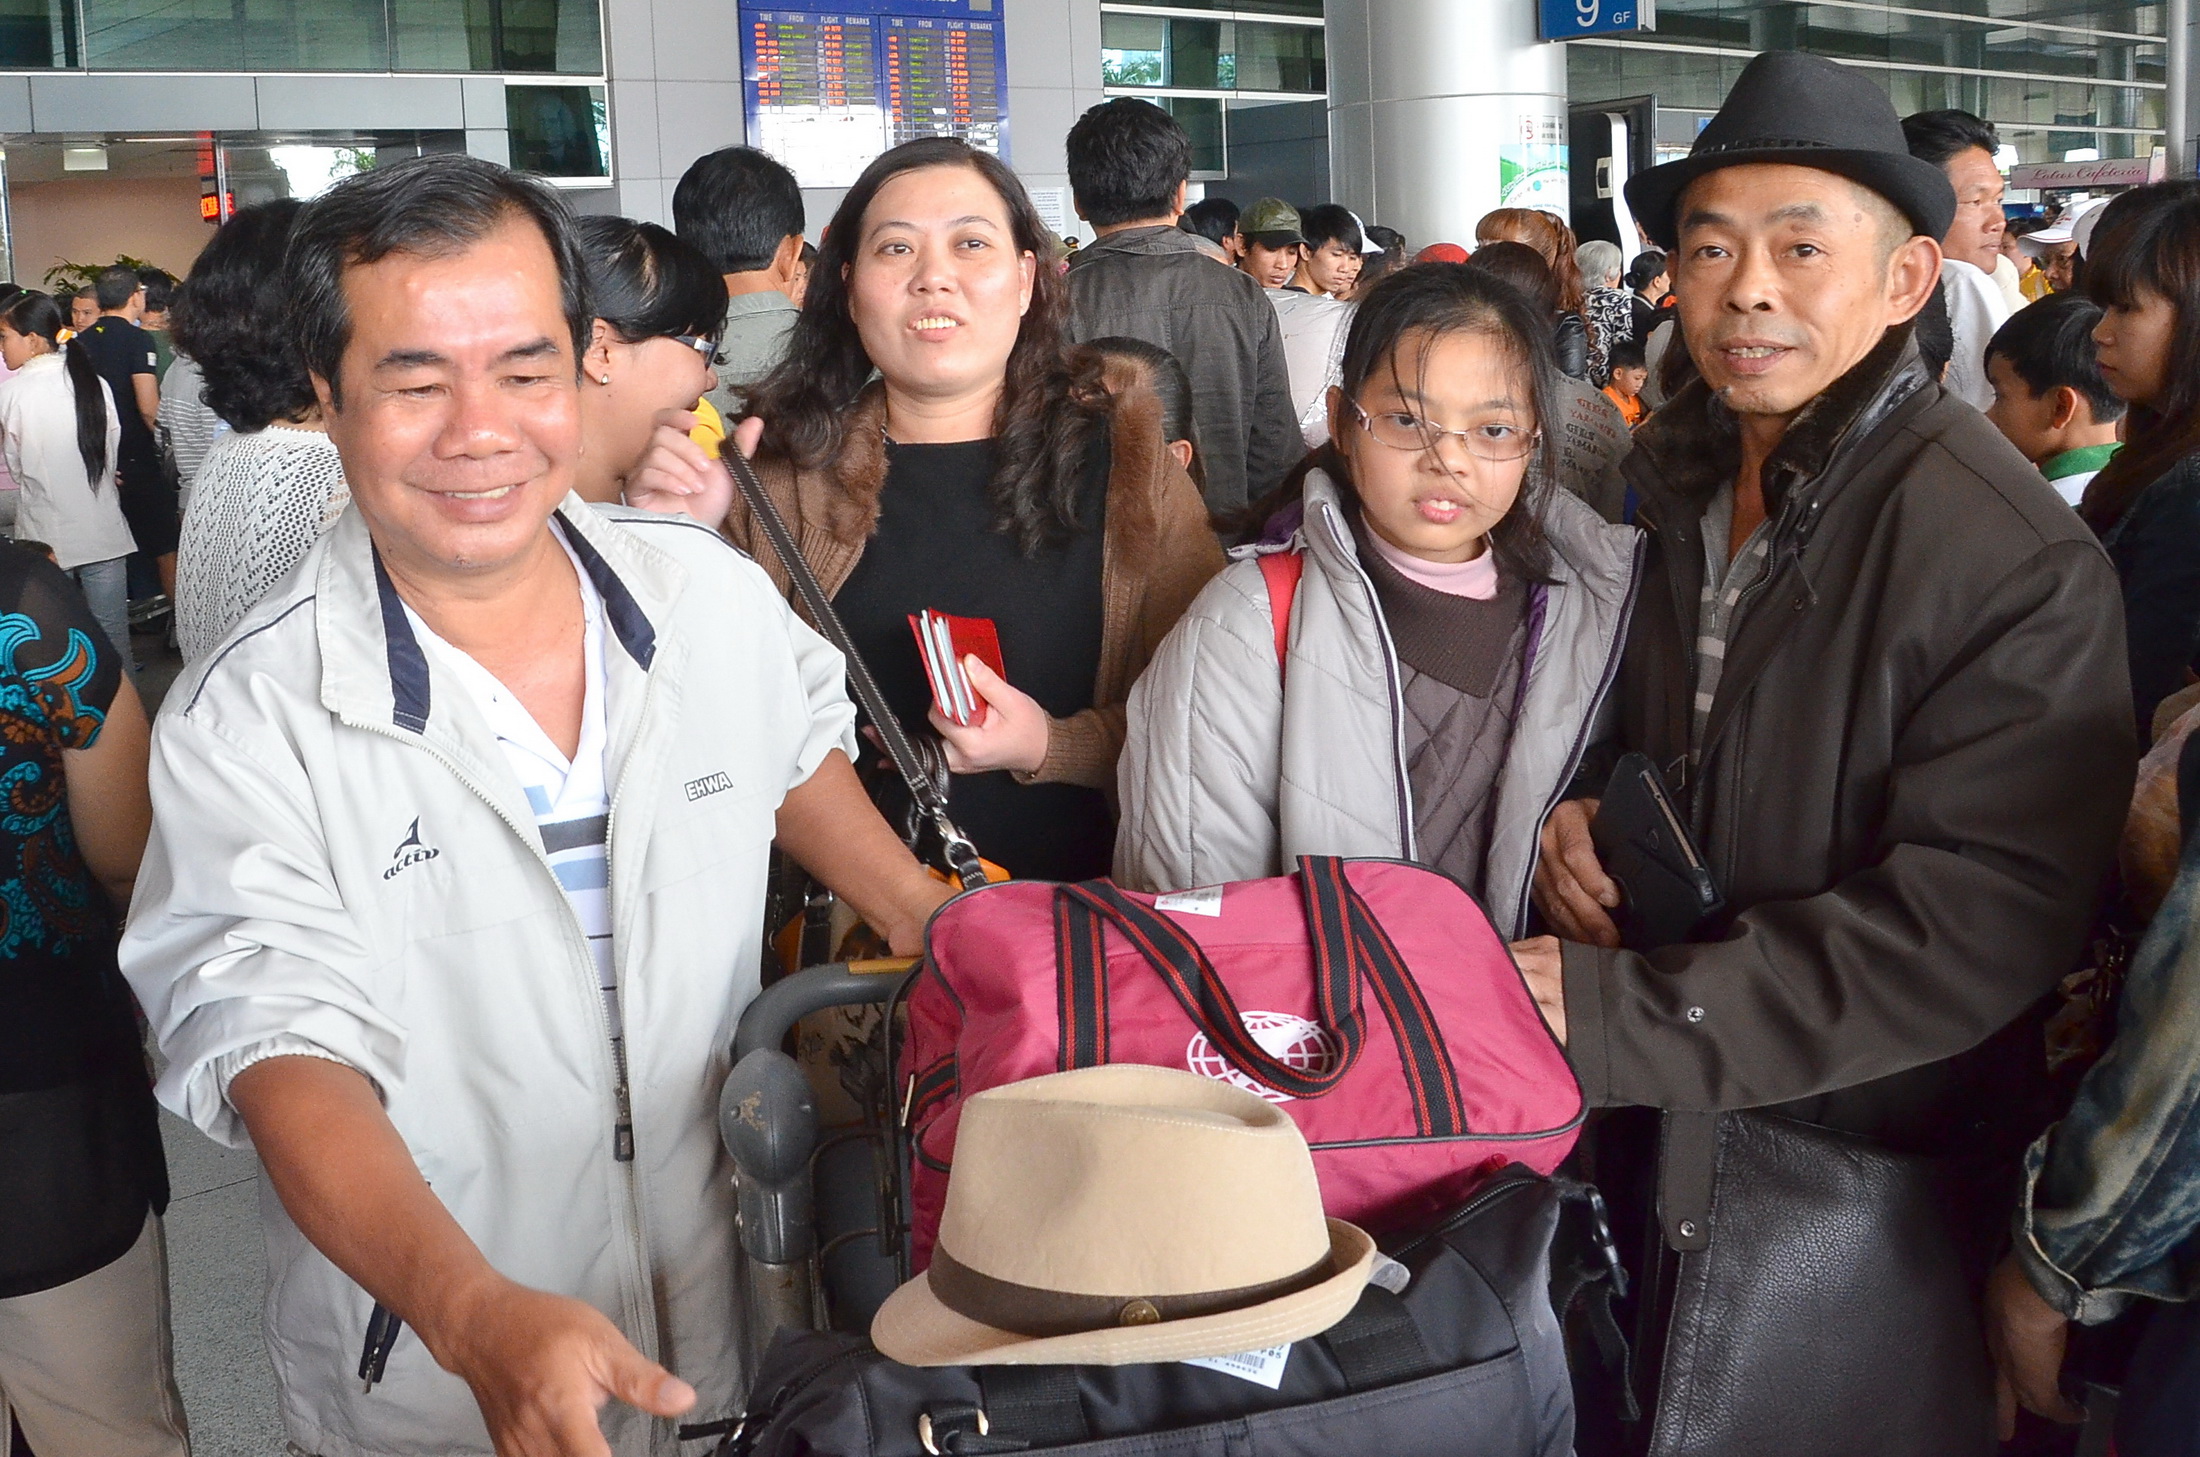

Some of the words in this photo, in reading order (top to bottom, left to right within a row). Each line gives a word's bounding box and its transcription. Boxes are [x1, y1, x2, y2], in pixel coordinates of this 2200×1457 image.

[760, 13, 773, 22] TIME
[788, 15, 804, 23] FROM
[820, 16, 839, 24] FLIGHT
[845, 17, 870, 25] REMARKS
[891, 19, 904, 27] TIME
[918, 20, 932, 28] FROM
[947, 21, 964, 29] FLIGHT
[970, 22, 992, 30] REMARKS
[1576, 0, 1599, 27] 9
[1613, 11, 1631, 24] GF
[2031, 168, 2075, 181] Lotus
[2077, 162, 2143, 183] Cafeteria
[684, 771, 733, 802] EHWA
[383, 848, 440, 881] activ
